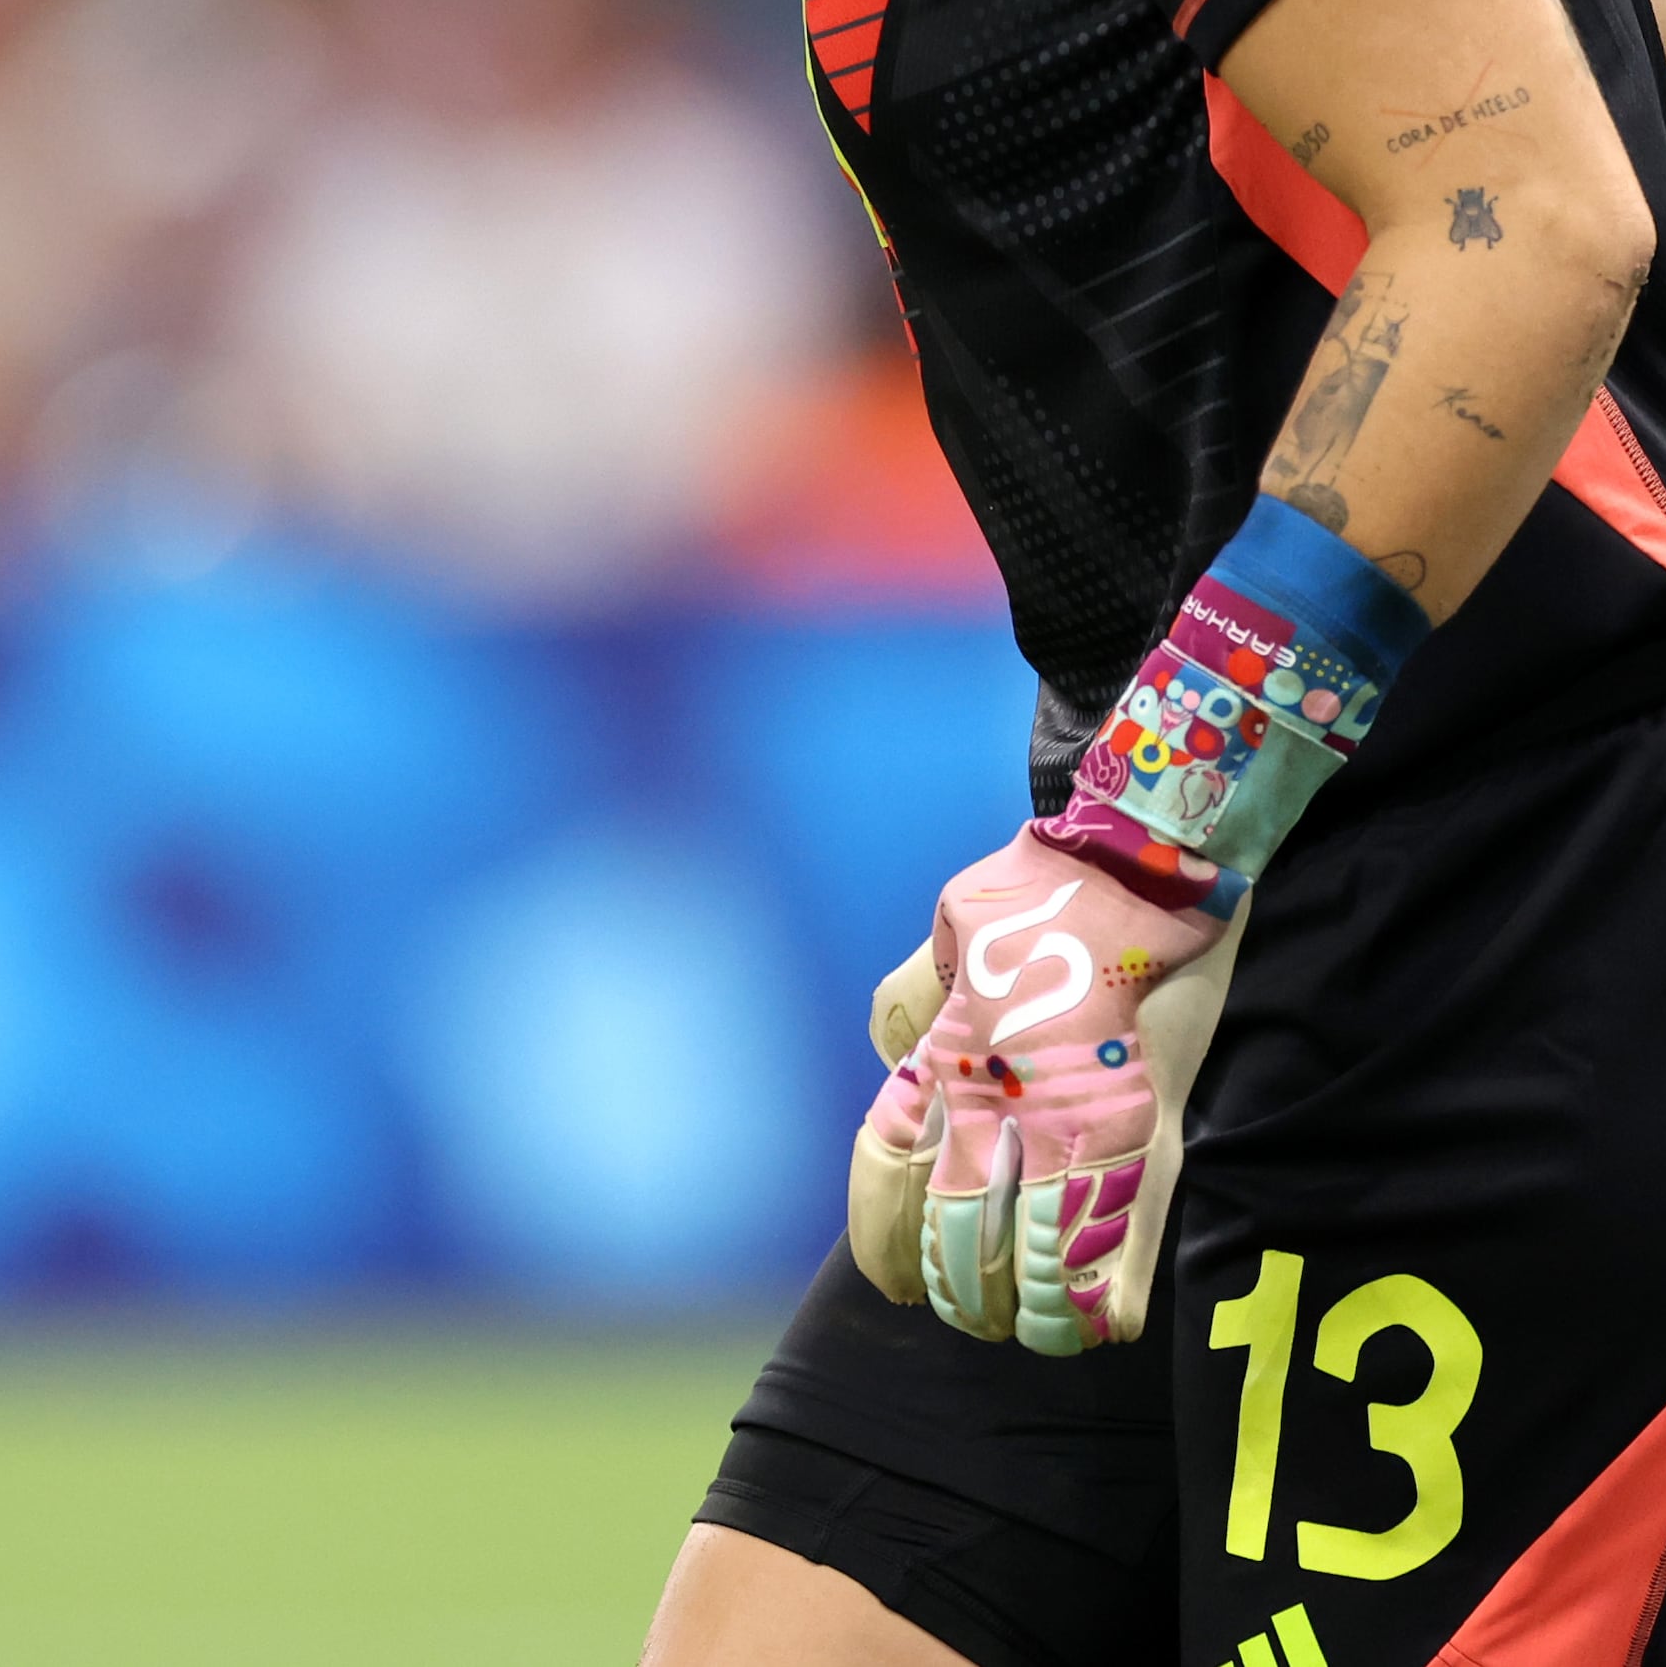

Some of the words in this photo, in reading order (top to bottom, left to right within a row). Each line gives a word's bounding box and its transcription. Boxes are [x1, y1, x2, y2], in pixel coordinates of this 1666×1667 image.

[1386, 123, 1438, 154] CORA
[1439, 109, 1468, 134] DE
[1471, 86, 1531, 120] HIELO
[1209, 1249, 1483, 1581] 13
